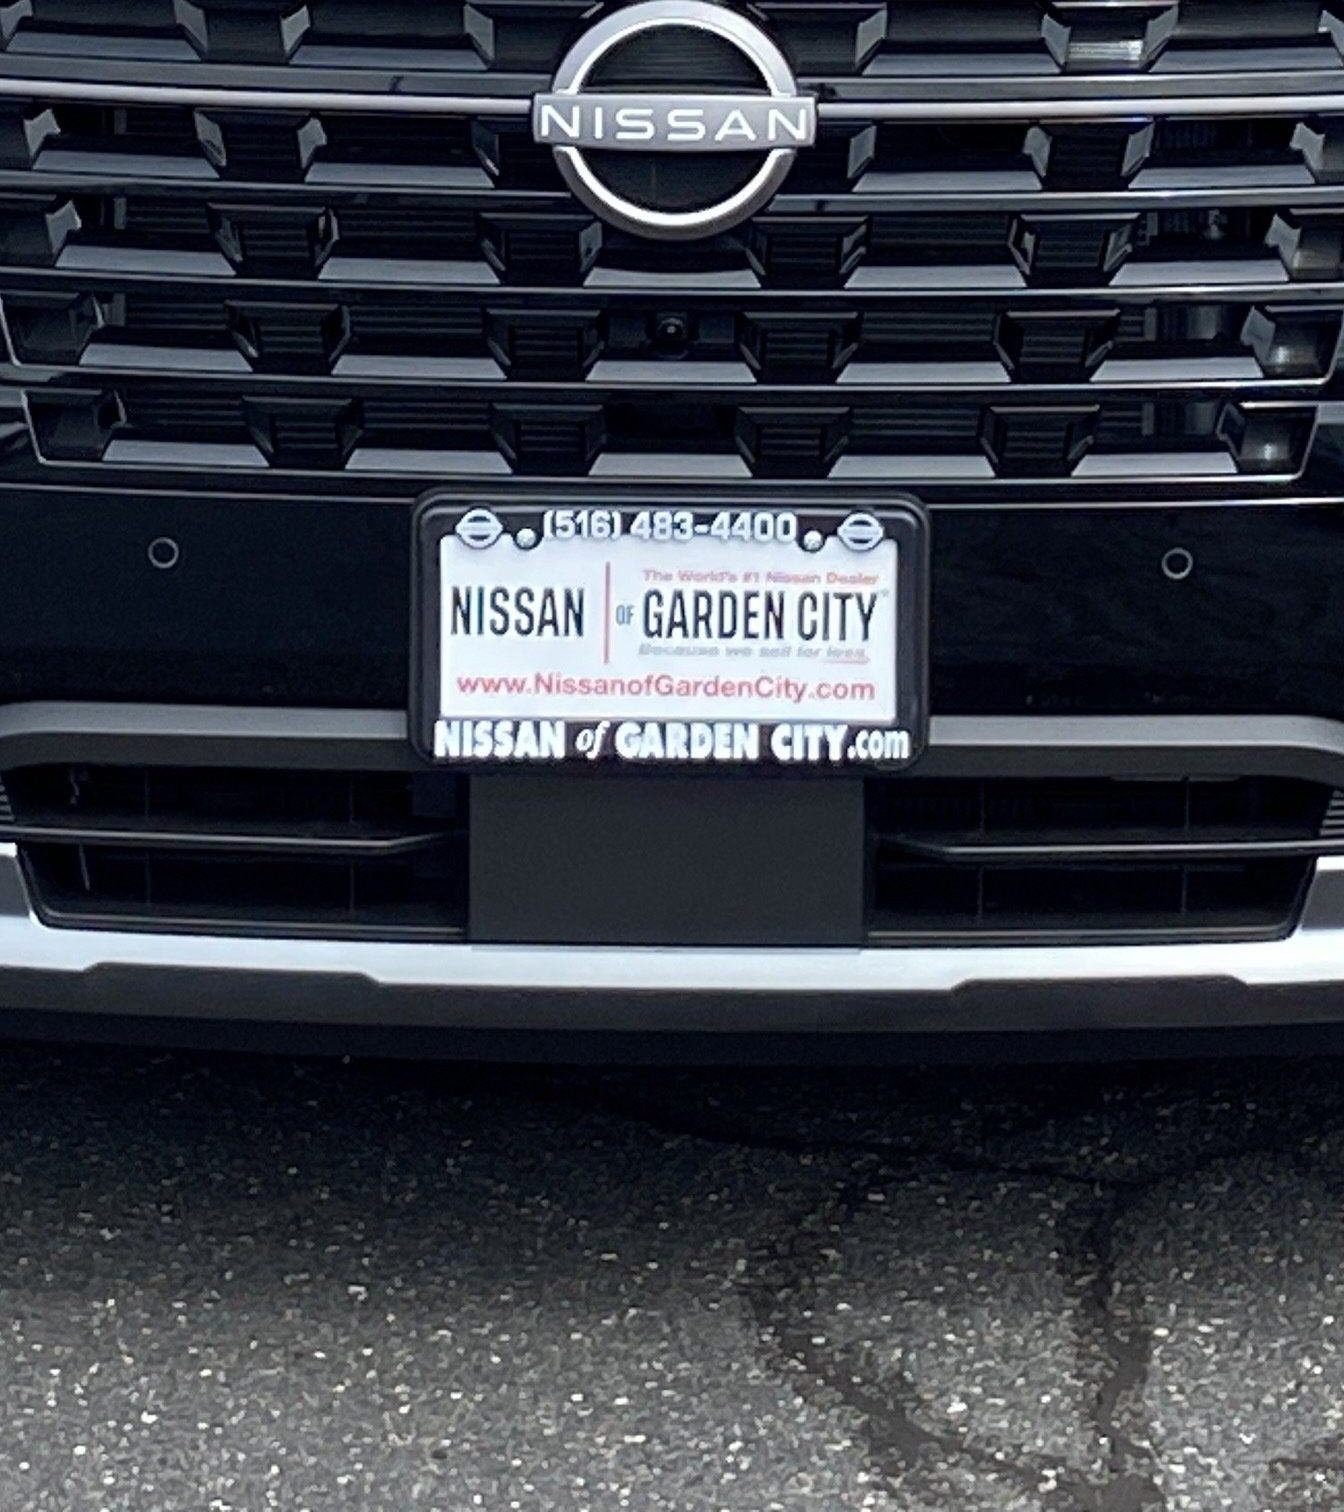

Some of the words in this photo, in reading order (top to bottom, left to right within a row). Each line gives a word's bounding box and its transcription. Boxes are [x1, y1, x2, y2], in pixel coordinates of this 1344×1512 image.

[540, 104, 807, 142] NISSAN
[543, 509, 622, 541] (516)
[630, 510, 798, 543] 483-4400
[643, 568, 673, 582] The
[766, 571, 821, 585] Nissan
[826, 571, 879, 586] Dealer
[451, 586, 584, 636] NISSAN
[616, 604, 634, 626] OF
[643, 588, 785, 640] GARDEN
[798, 591, 878, 642] CITY
[456, 672, 875, 704] www.NissanofGardenCity.com
[434, 720, 565, 758] NISSAN
[575, 720, 610, 760] of
[614, 721, 759, 760] GARDEN
